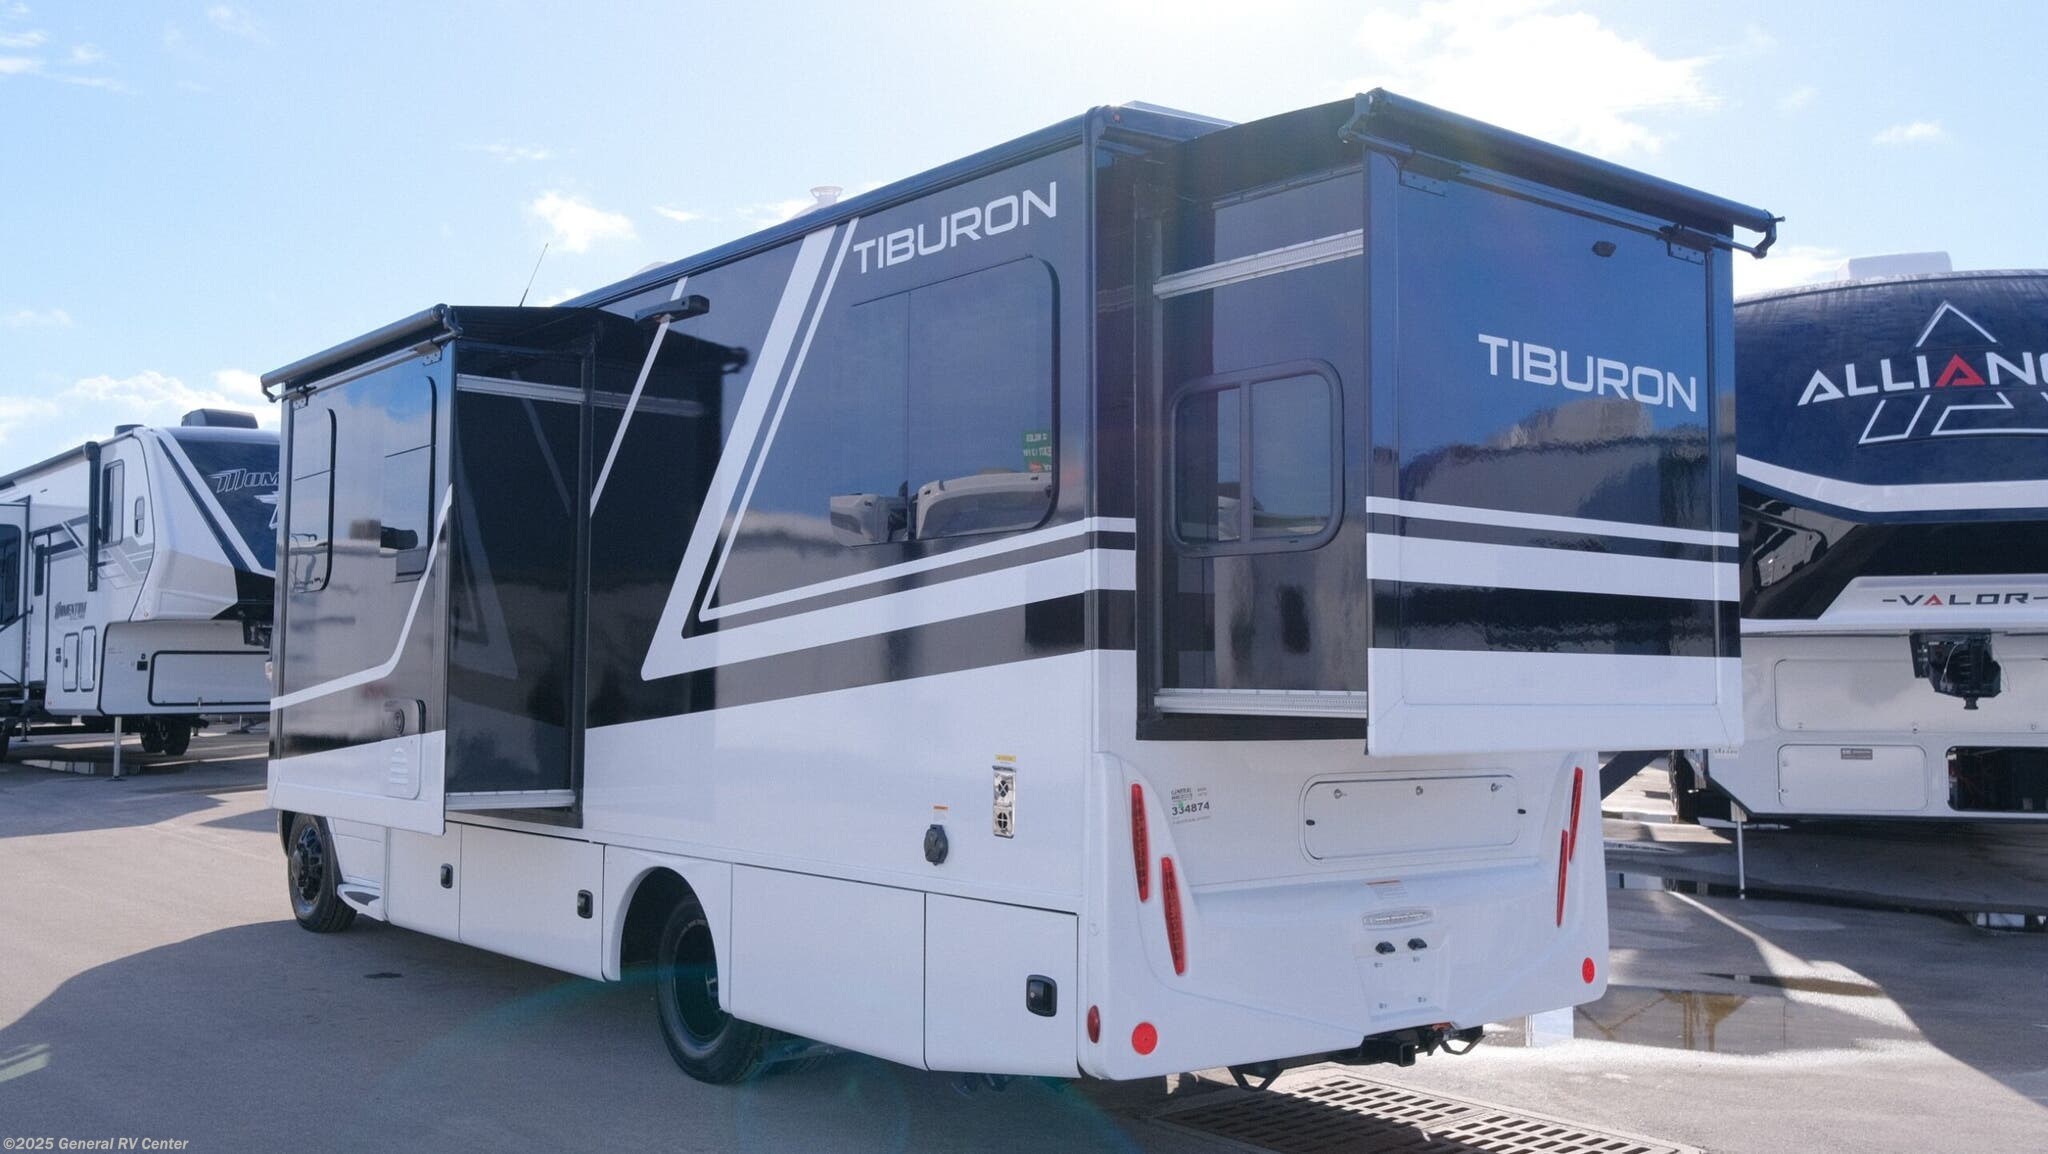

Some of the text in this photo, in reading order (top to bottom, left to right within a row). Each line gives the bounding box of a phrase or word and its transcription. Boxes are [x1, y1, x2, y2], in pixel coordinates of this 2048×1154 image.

[853, 181, 1057, 274] TIBURON
[1478, 333, 1697, 412] TIBURON
[1797, 352, 2048, 406] ALLIAN
[1171, 801, 1210, 816] 334874
